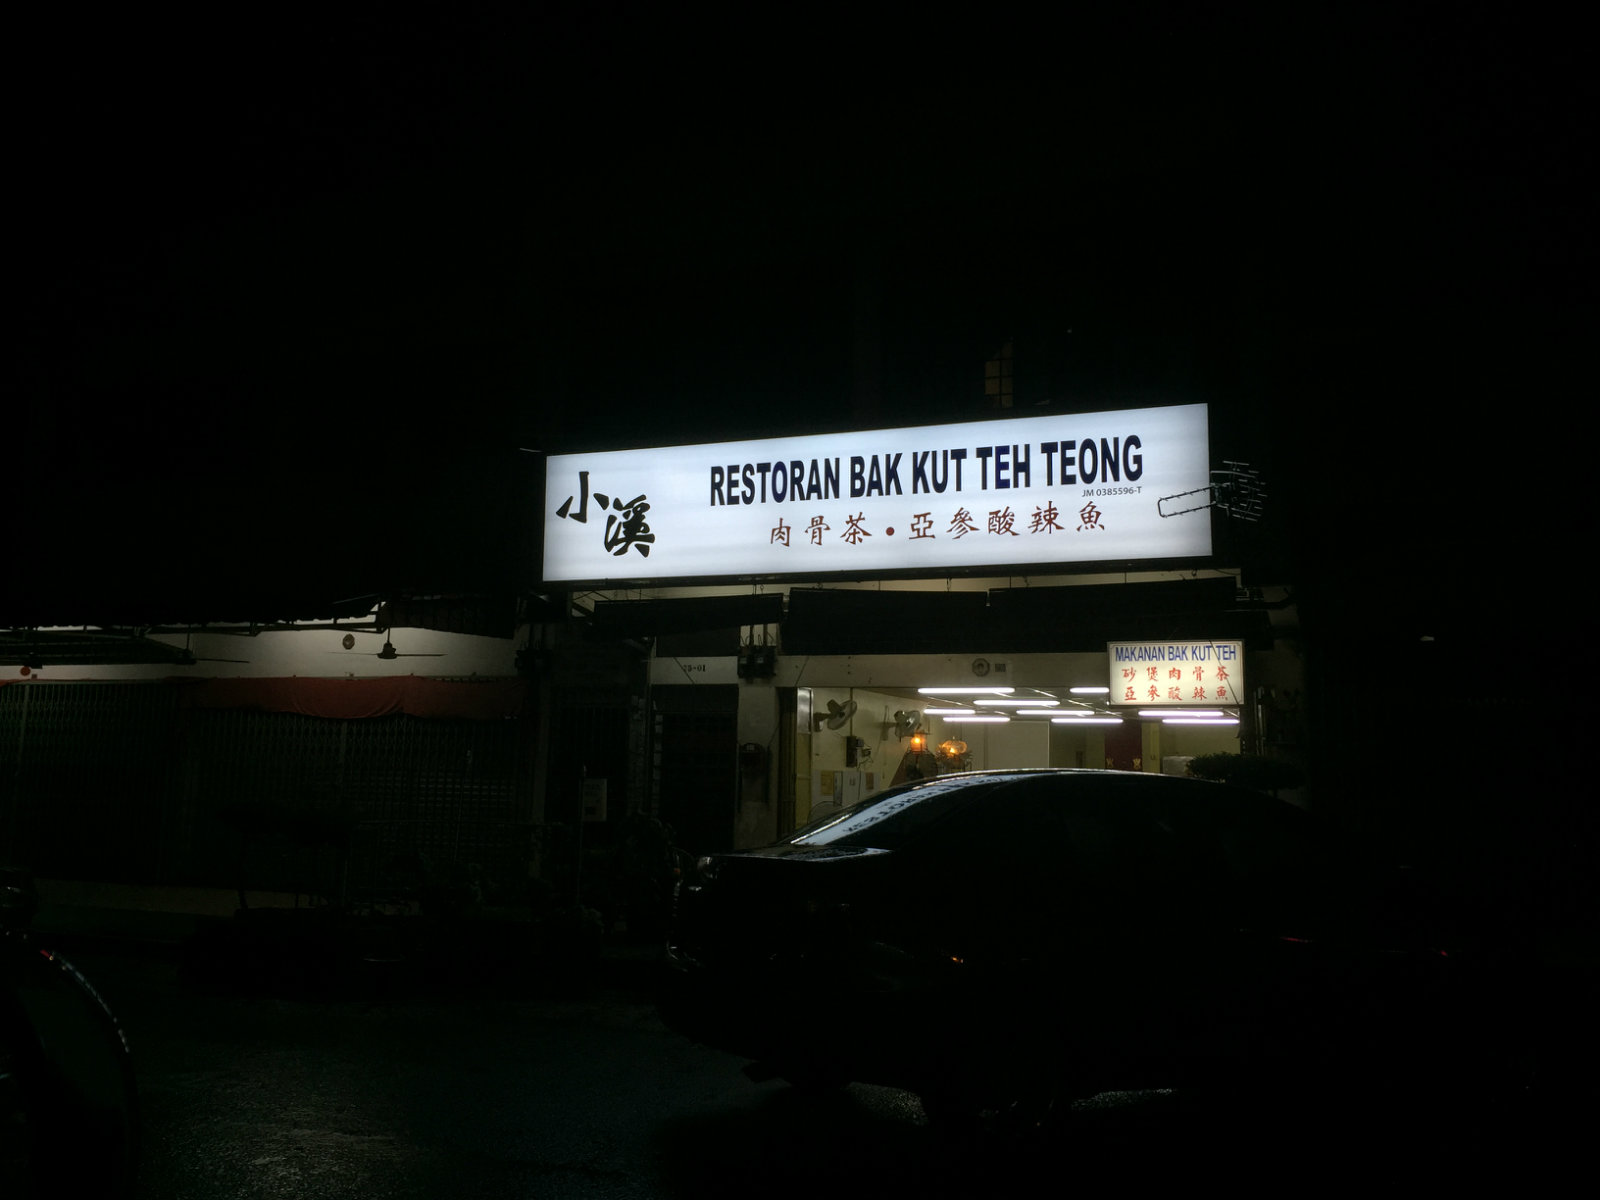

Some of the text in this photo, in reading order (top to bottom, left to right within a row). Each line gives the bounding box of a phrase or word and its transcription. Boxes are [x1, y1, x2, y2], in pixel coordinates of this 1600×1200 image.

[710, 434, 1143, 506] RESTORAN BAK KUT TEH TEONG
[1082, 486, 1142, 498] JM 0385596-T
[556, 471, 655, 558] 小溪
[1115, 645, 1236, 661] MAKANAN BAK KUT TEH
